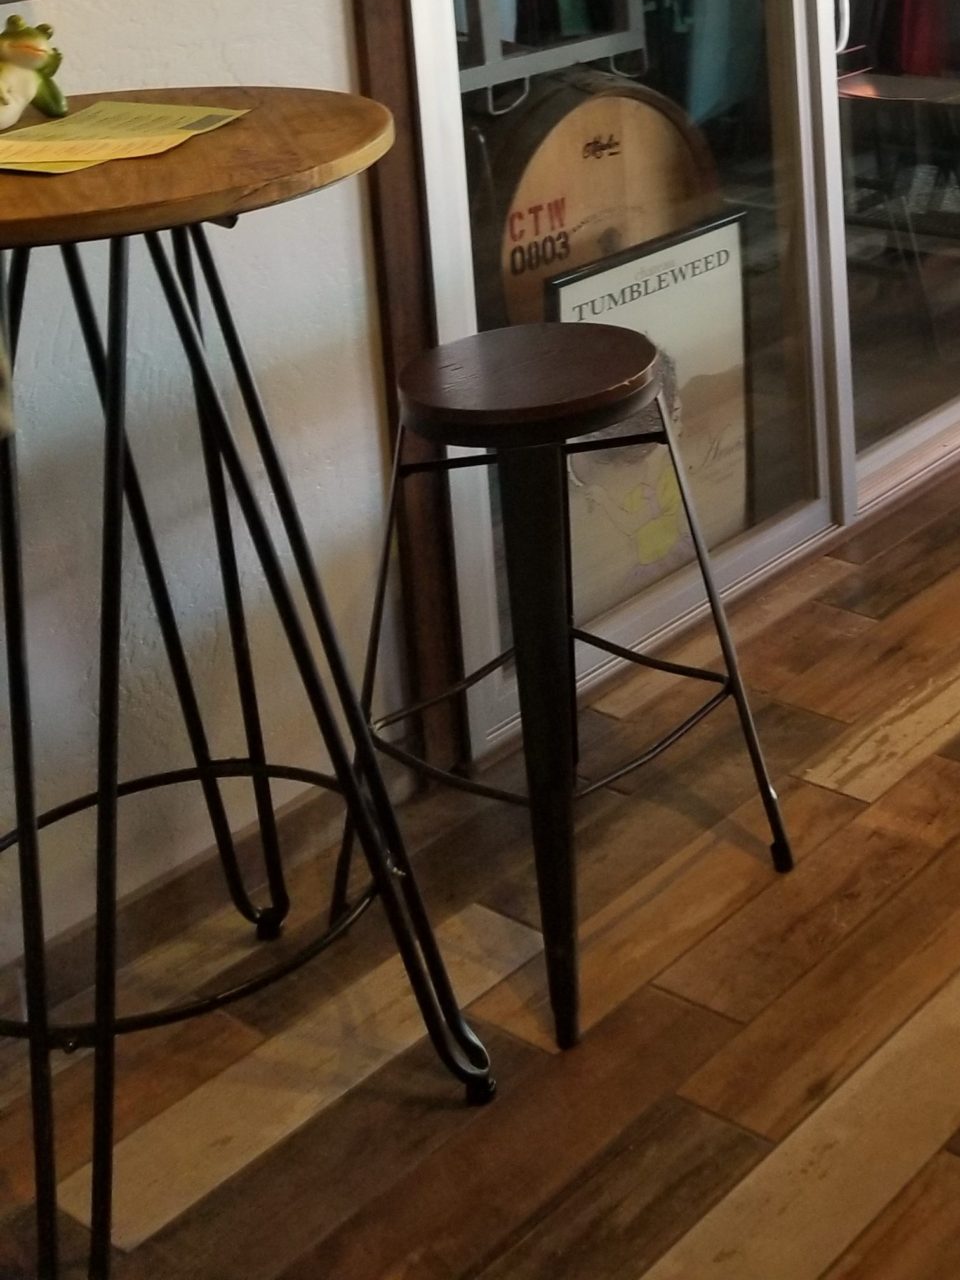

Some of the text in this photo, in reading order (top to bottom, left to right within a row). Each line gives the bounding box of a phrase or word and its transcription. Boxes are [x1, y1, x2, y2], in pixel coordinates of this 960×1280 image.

[508, 197, 567, 243] CTW
[509, 231, 571, 276] 0003
[571, 248, 731, 322] TUMBLEWEED
